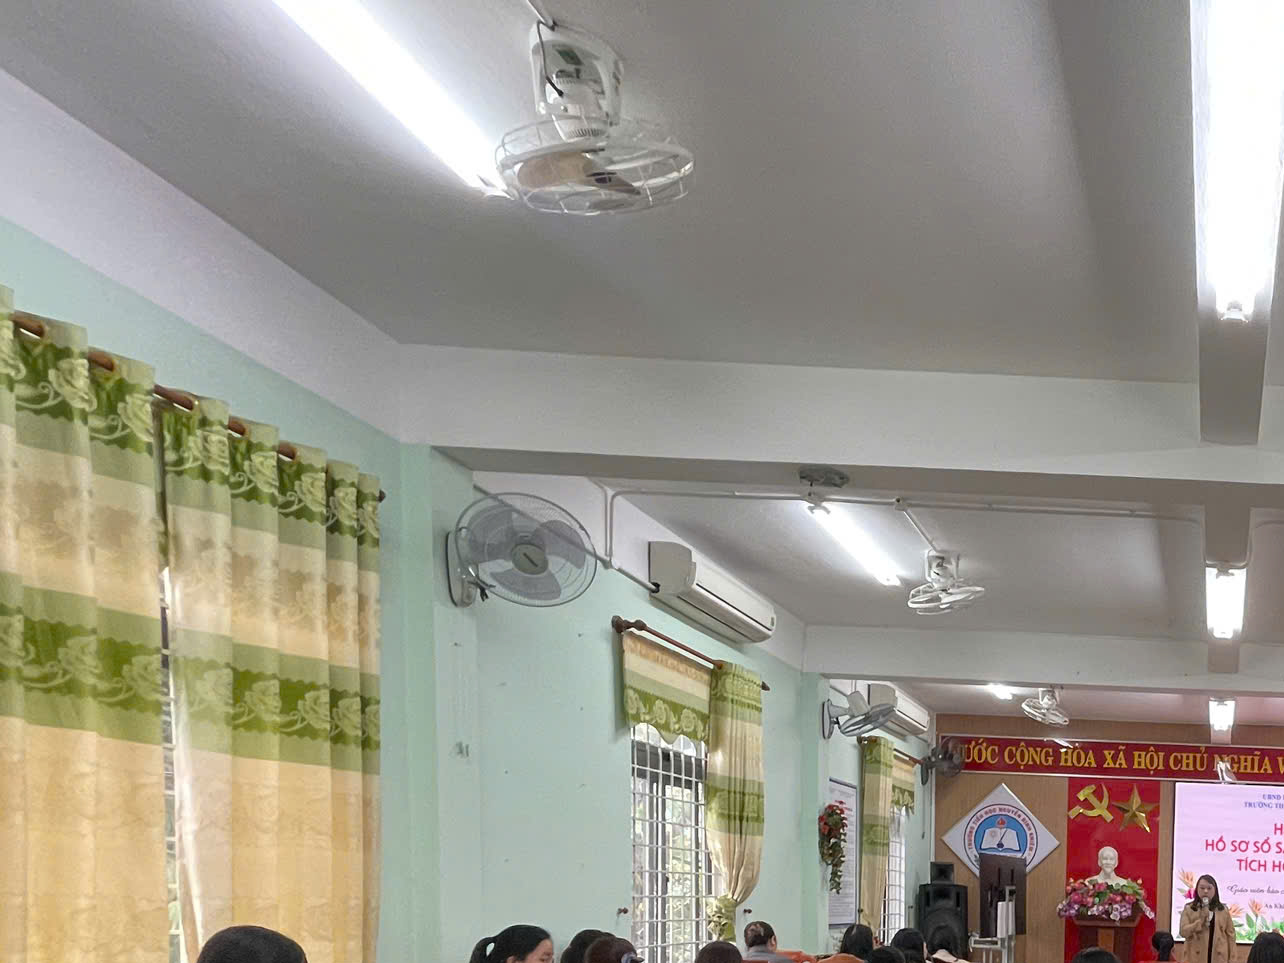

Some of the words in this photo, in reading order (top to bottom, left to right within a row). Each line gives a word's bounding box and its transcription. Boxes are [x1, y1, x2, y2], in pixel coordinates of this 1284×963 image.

[1004, 741, 1054, 770] CỘNG
[1059, 742, 1097, 768] HÒA
[1103, 745, 1128, 769] XÃ
[1133, 746, 1165, 775] HỘI
[1169, 746, 1208, 771] CHỦ
[1230, 840, 1250, 853] SƠ
[1236, 857, 1267, 872] TÍCH
